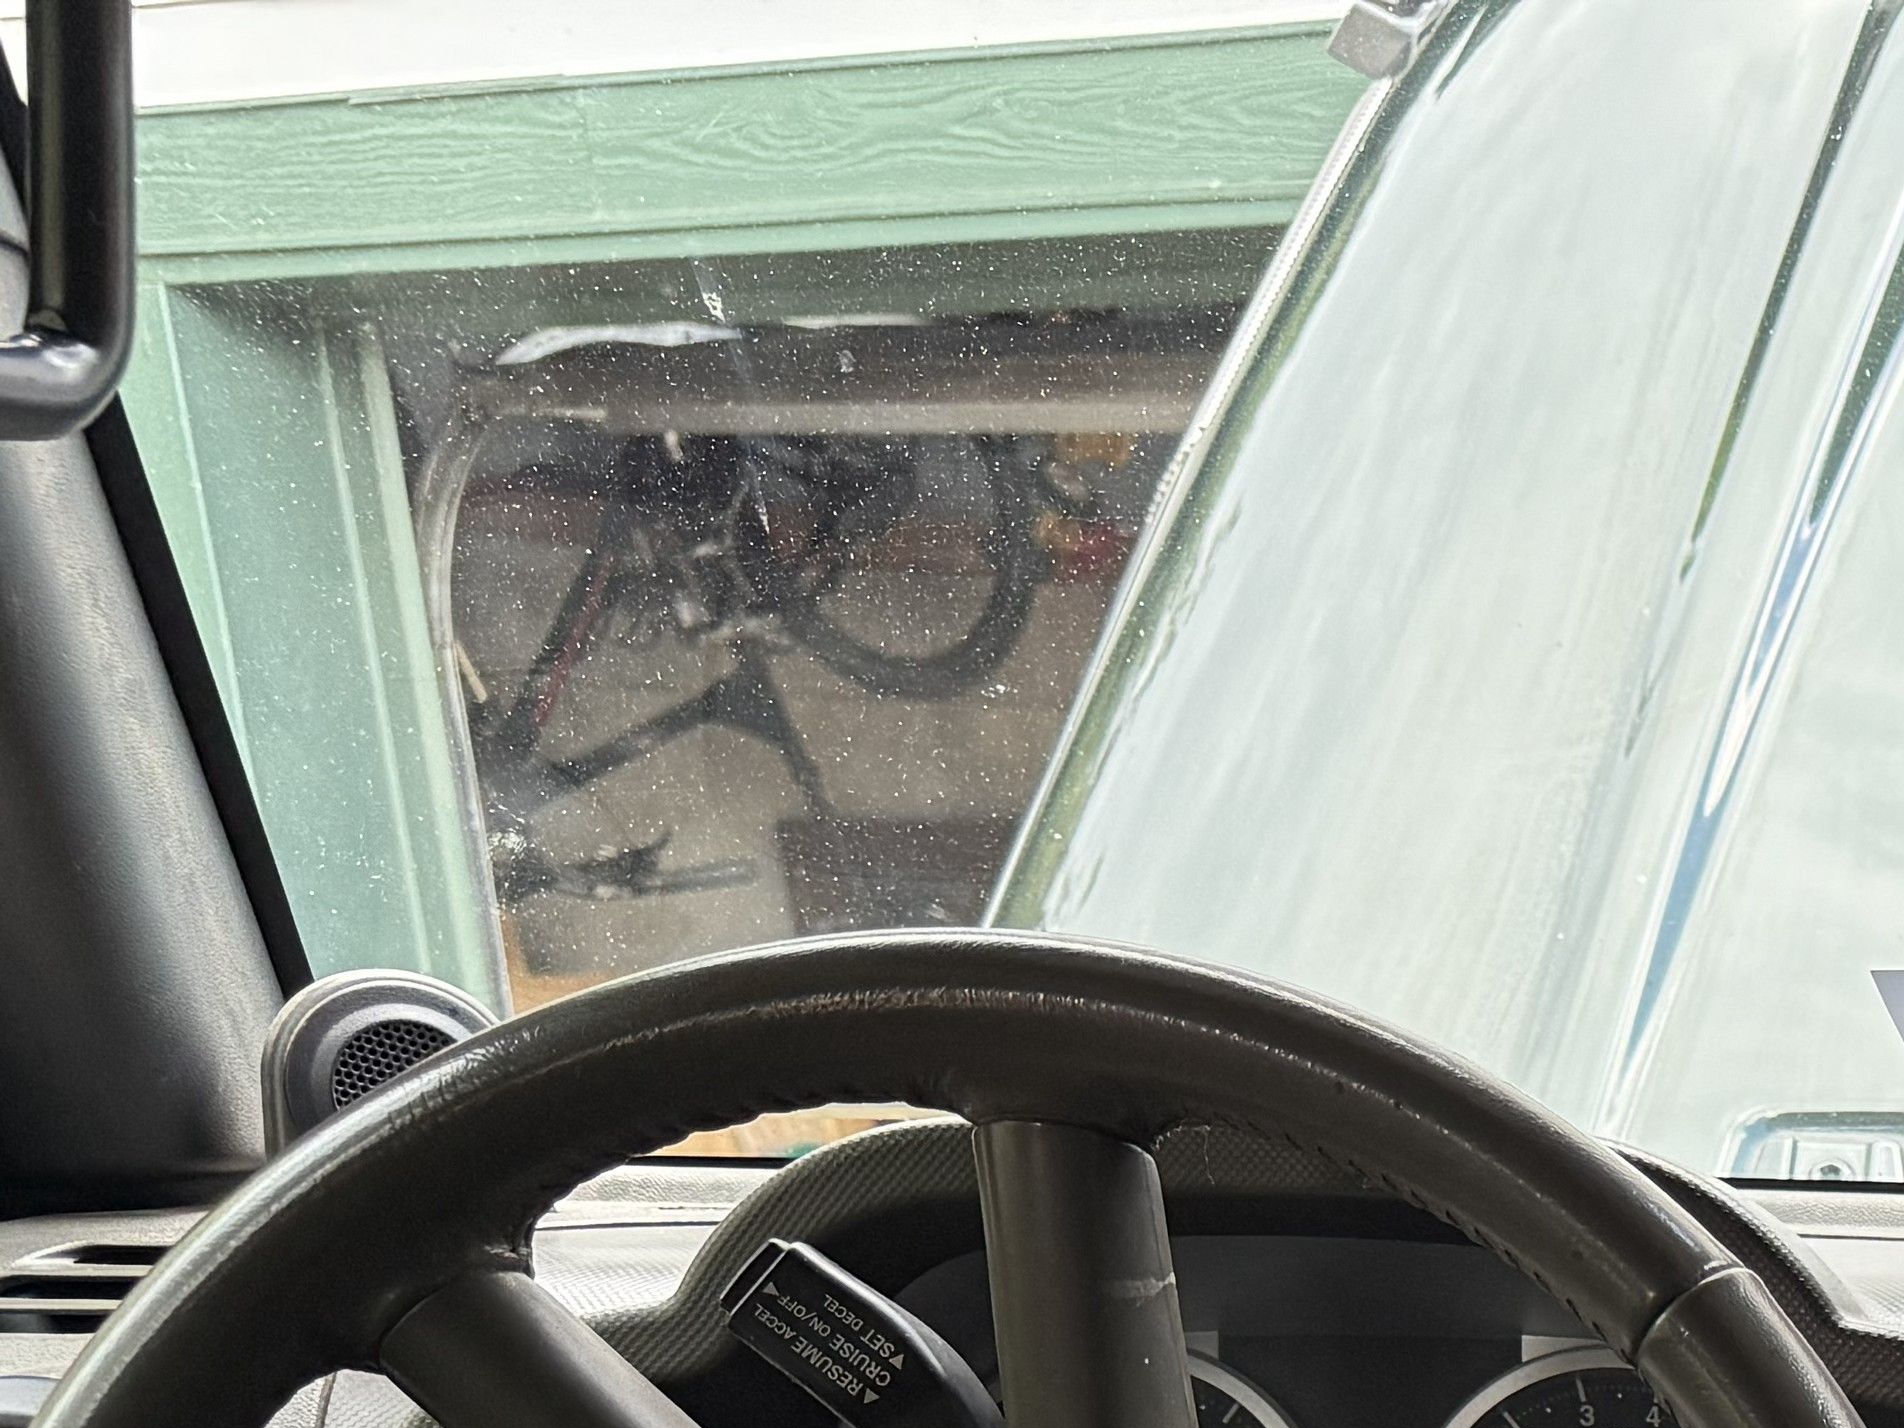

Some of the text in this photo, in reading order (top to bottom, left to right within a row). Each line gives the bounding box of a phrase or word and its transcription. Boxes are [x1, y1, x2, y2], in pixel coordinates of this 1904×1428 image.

[754, 1303, 864, 1397] RESUME ACCEL
[776, 1295, 891, 1387] CRUISE ON/OFF
[823, 1293, 896, 1358] SET DECEL
[1580, 1404, 1595, 1428] 3
[1646, 1405, 1662, 1428] 4
